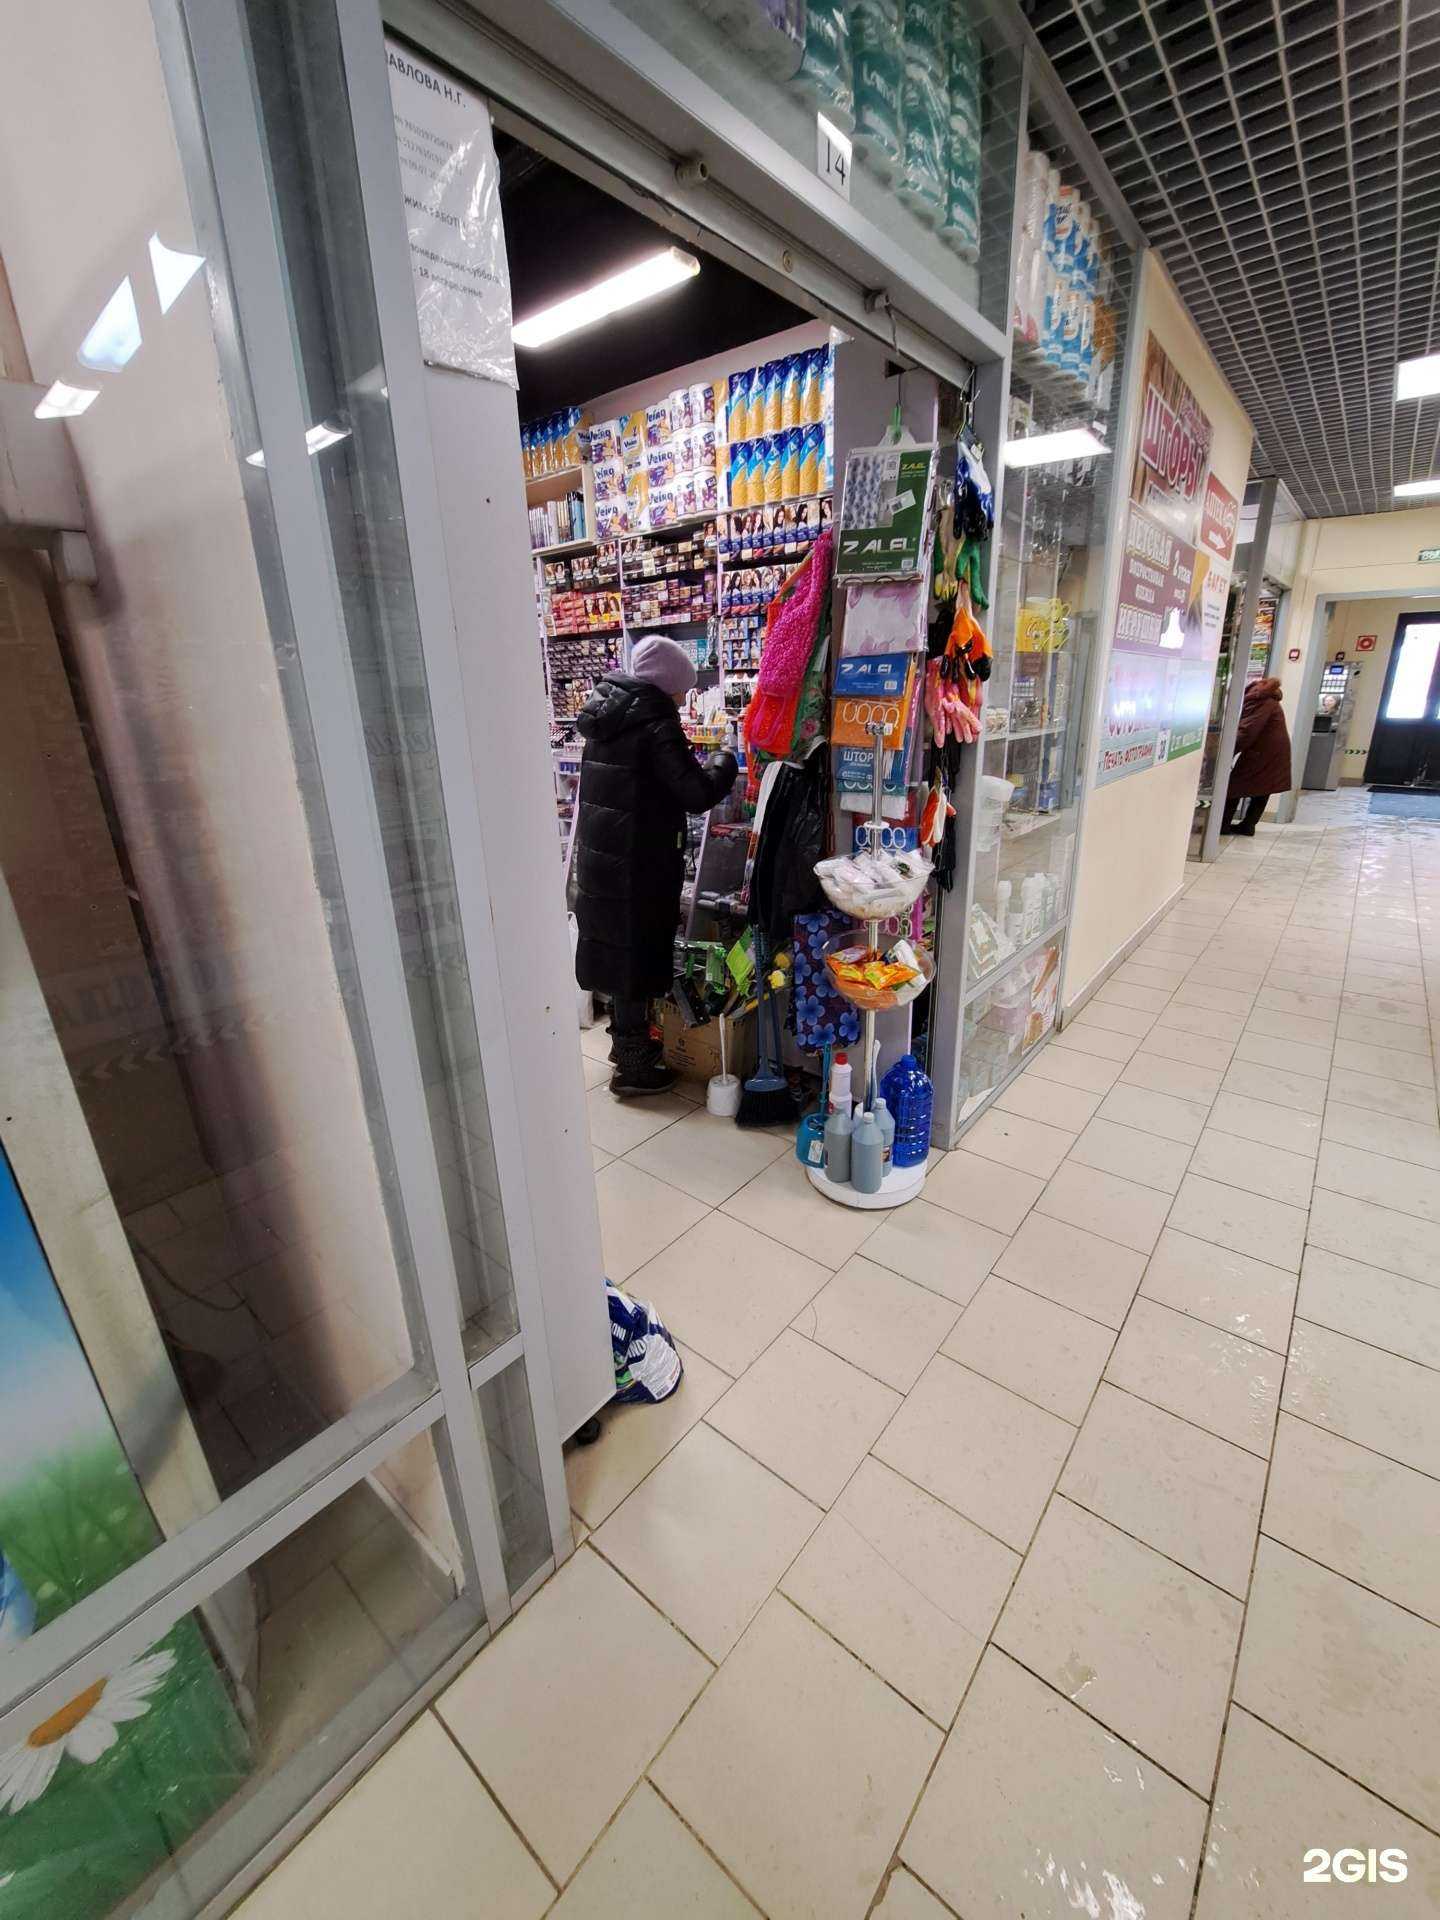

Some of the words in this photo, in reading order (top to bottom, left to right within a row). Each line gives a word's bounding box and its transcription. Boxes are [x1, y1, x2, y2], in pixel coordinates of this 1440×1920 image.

[387, 52, 441, 95] АВЛОВА
[825, 137, 847, 187] 14
[843, 750, 874, 762] ШТОР
